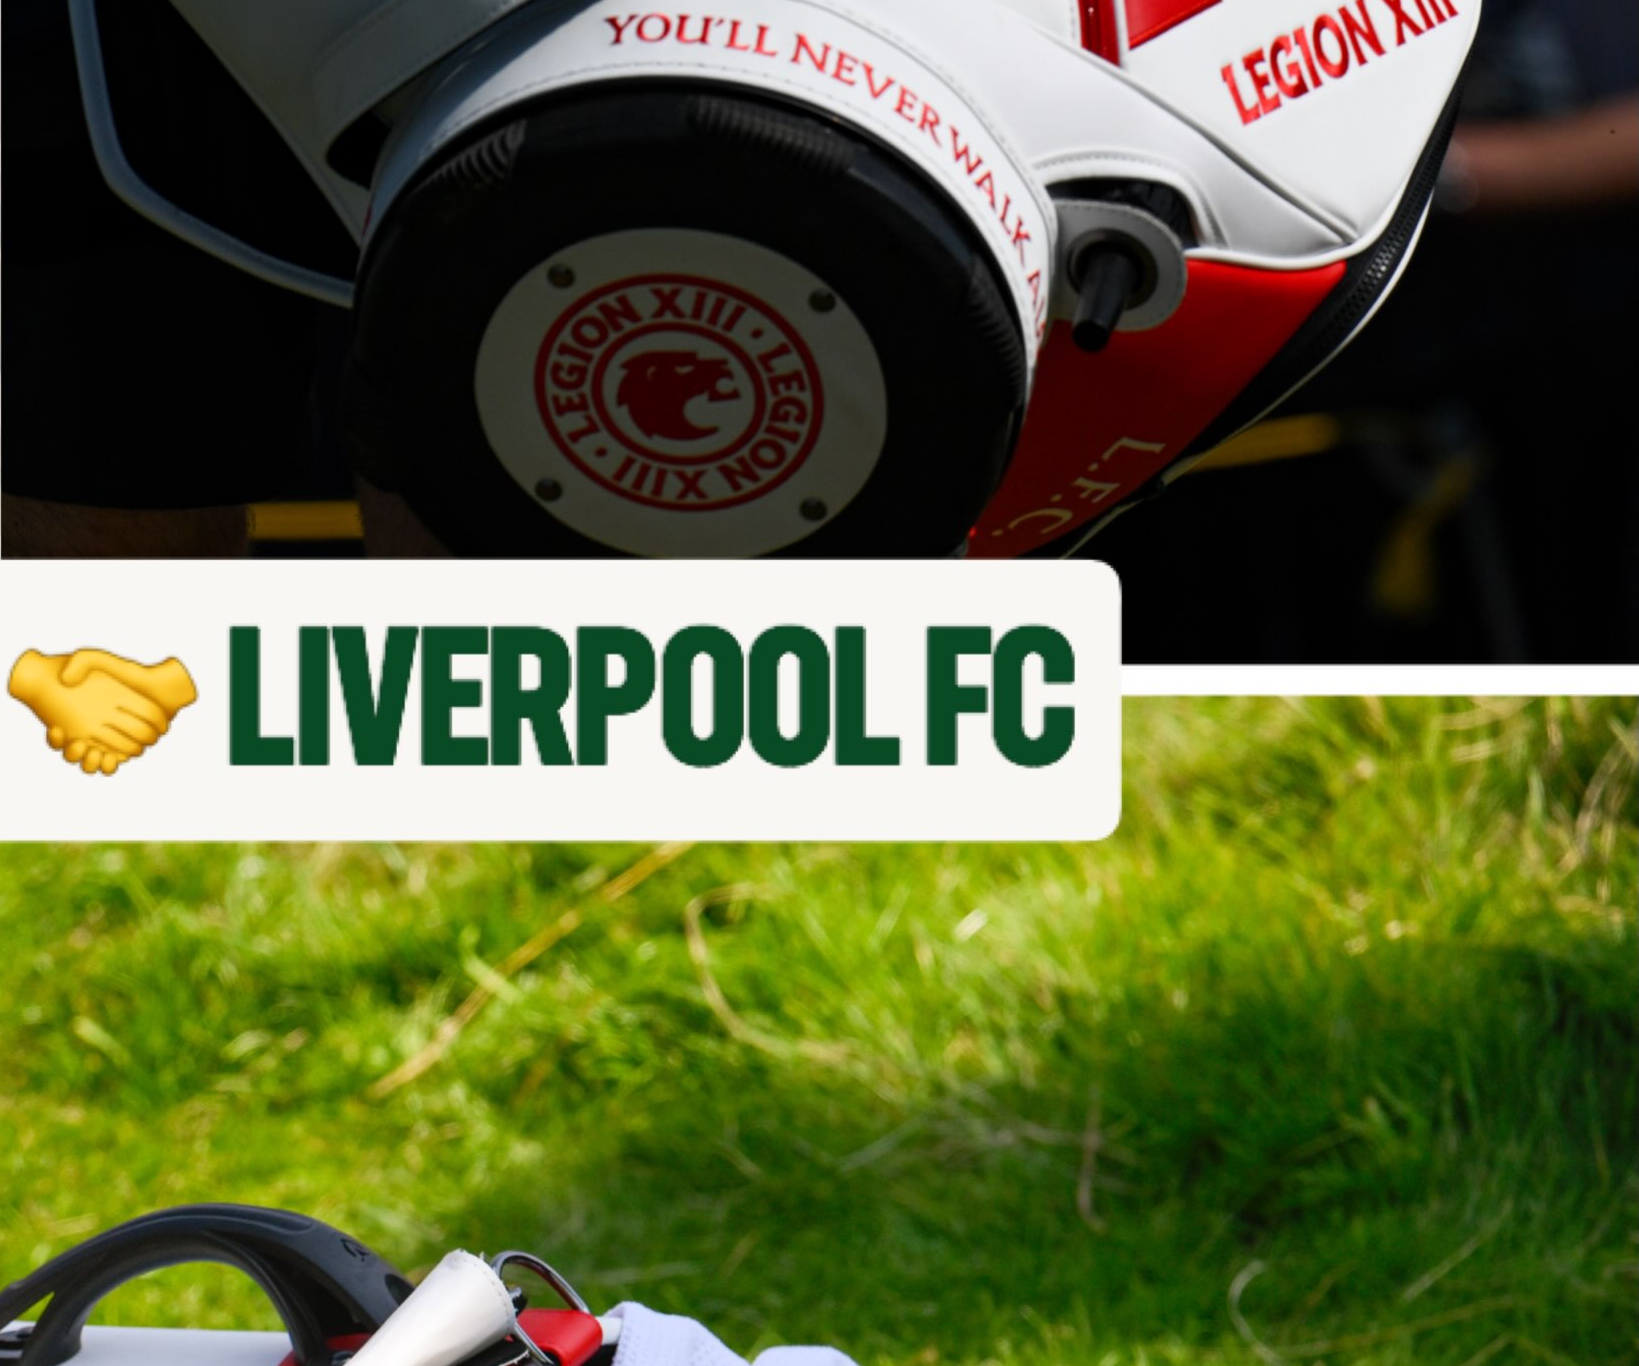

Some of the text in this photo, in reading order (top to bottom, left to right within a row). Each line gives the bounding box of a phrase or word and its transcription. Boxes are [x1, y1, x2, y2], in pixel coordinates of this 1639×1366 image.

[604, 12, 778, 58] YOU'LL
[790, 33, 943, 147] NEVER
[948, 125, 1031, 270] WALK
[550, 287, 749, 444] LEGION XIII
[611, 341, 808, 501] LEGION XIII
